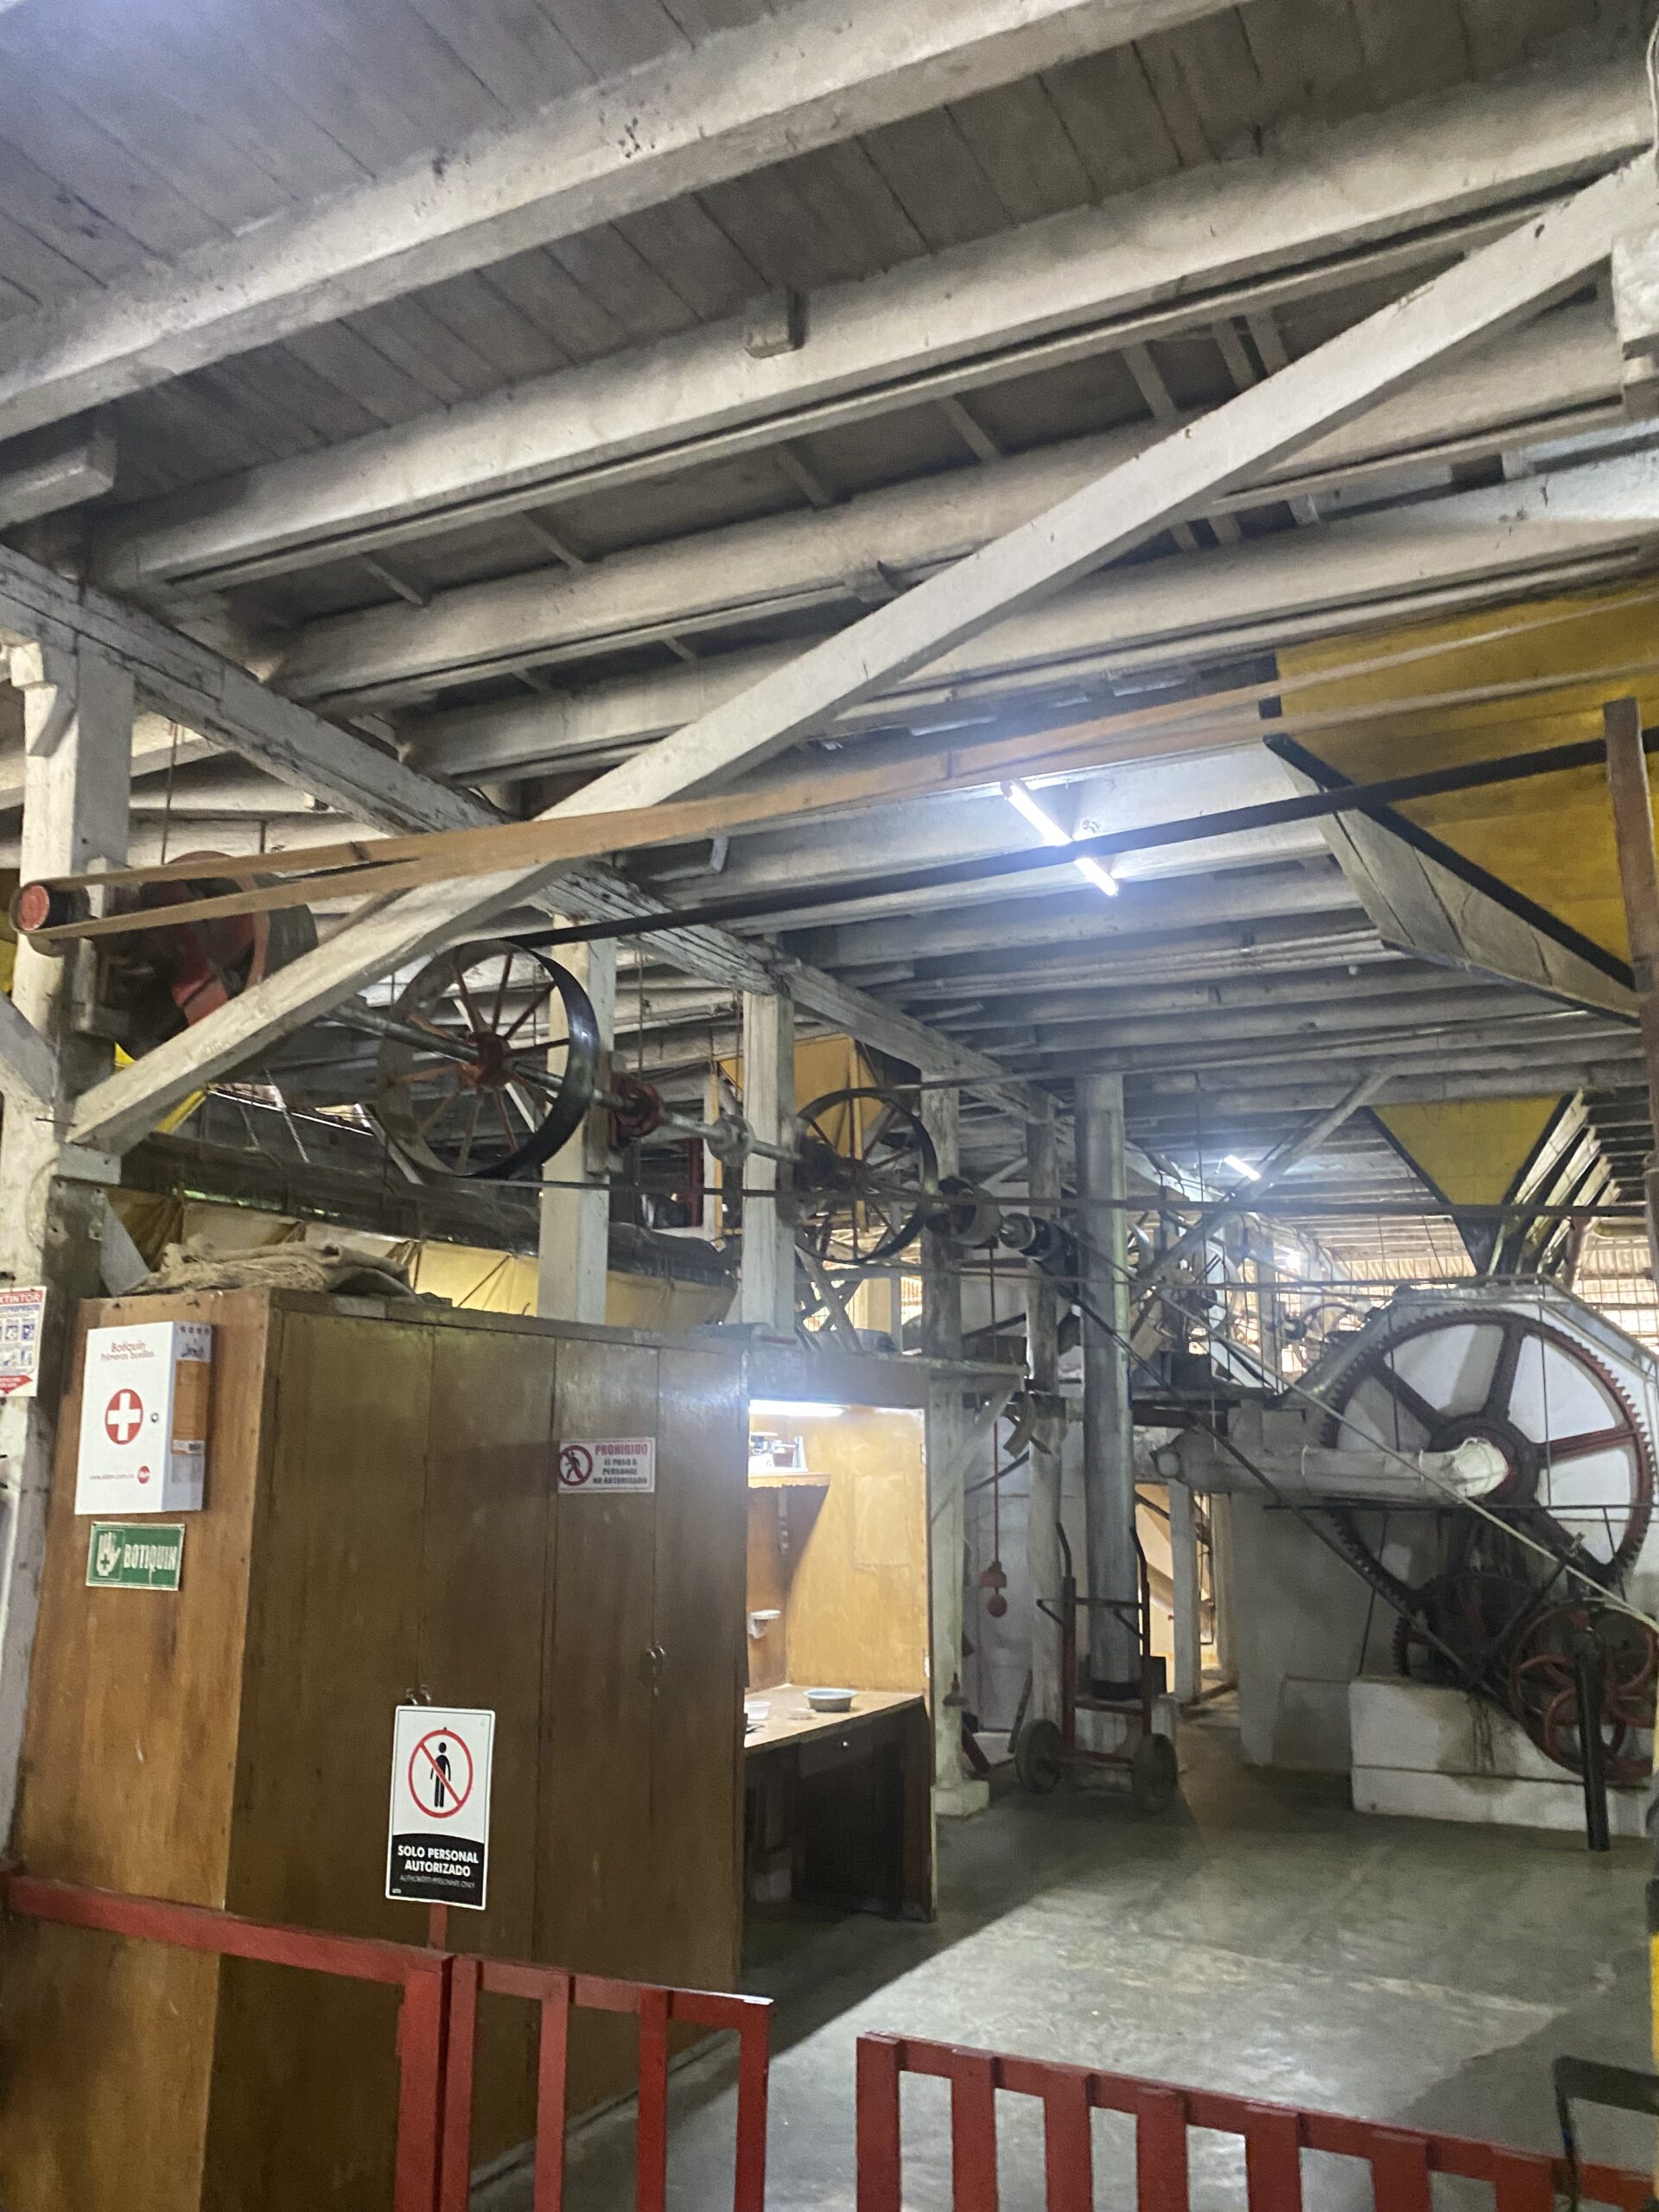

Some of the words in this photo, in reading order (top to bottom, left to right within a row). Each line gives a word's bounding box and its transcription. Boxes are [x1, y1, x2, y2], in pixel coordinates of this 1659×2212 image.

[0, 1293, 41, 1304] XTINTOR
[594, 1444, 648, 1456] PROHIBIDO
[124, 1543, 178, 1571] BOTIQUIN
[397, 1844, 425, 1858] SOLO
[428, 1847, 480, 1864] PERSONAL
[404, 1859, 471, 1878] AUTORIZADO
